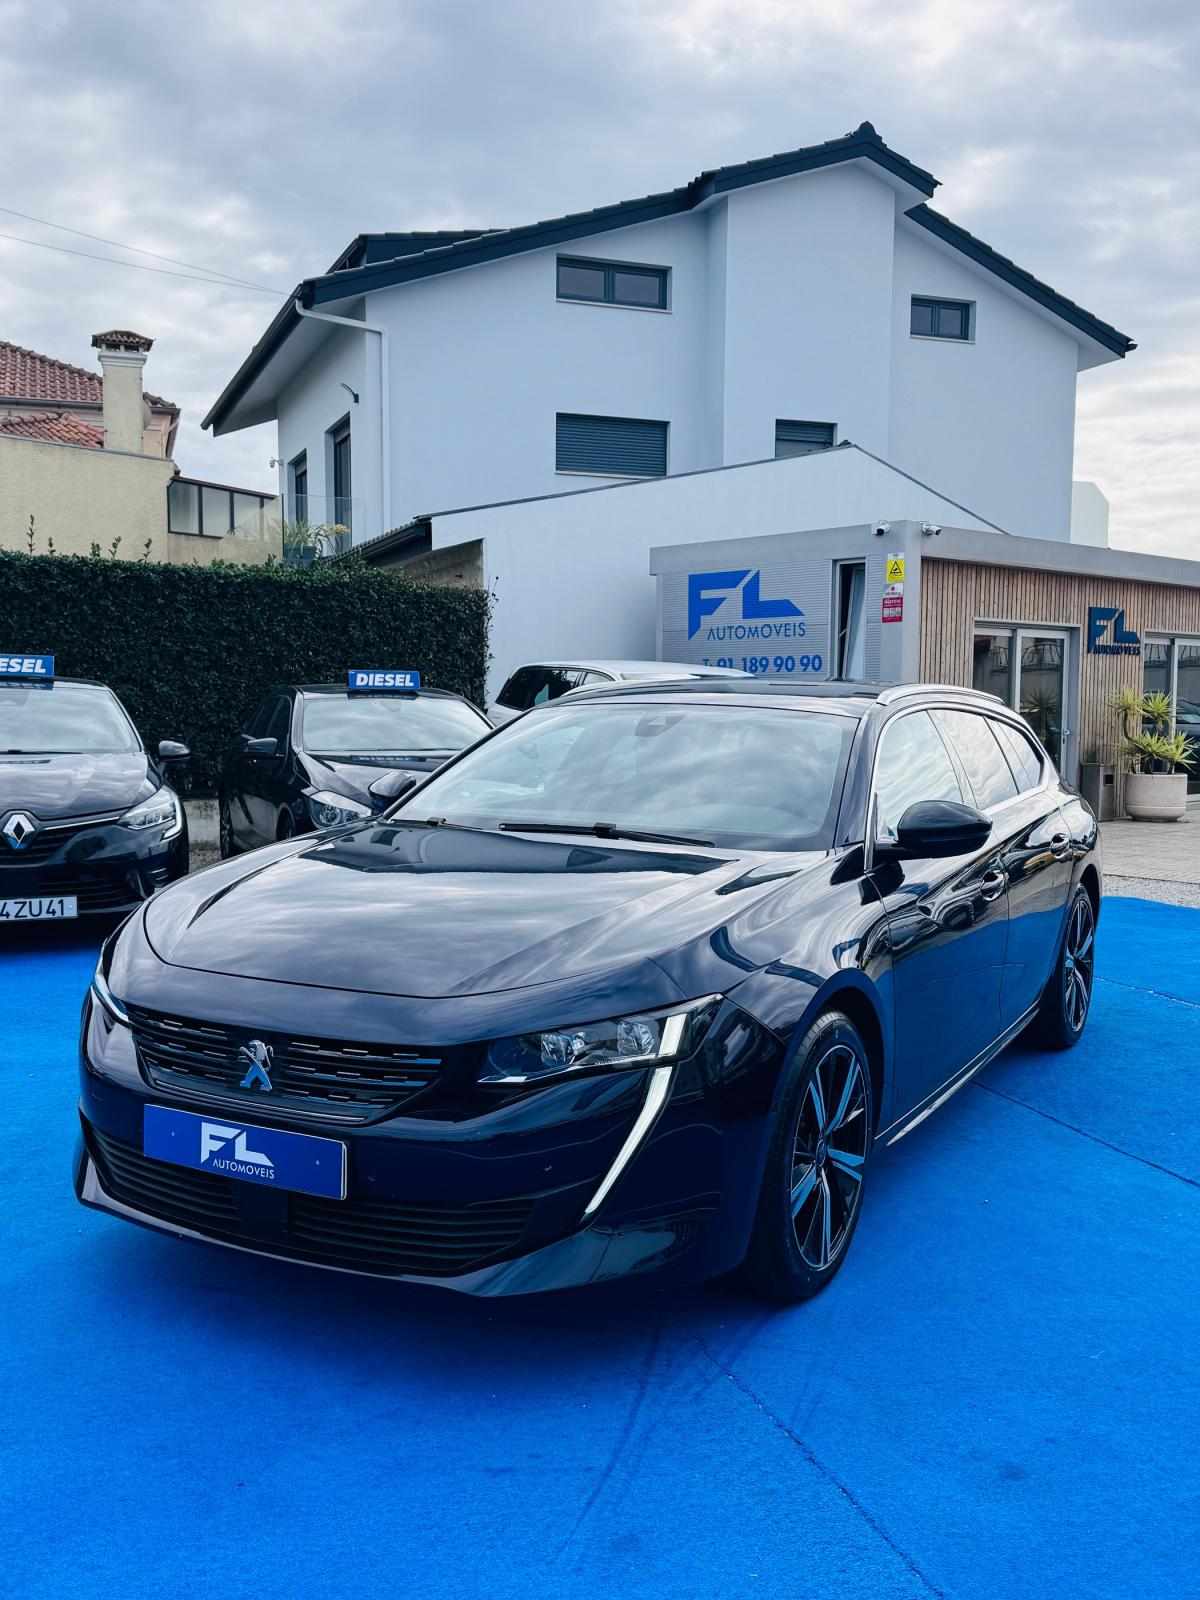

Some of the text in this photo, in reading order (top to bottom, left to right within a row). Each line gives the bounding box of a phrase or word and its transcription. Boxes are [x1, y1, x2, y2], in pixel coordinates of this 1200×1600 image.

[688, 570, 805, 640] FL
[1088, 607, 1140, 654] FL
[0, 657, 46, 673] ESEL
[742, 655, 769, 673] 189
[774, 656, 796, 672] 90
[800, 654, 822, 672] 90
[356, 673, 414, 686] DIESEL
[201, 1122, 275, 1167] FL
[213, 1158, 275, 1179] AUTOMOVEIS
